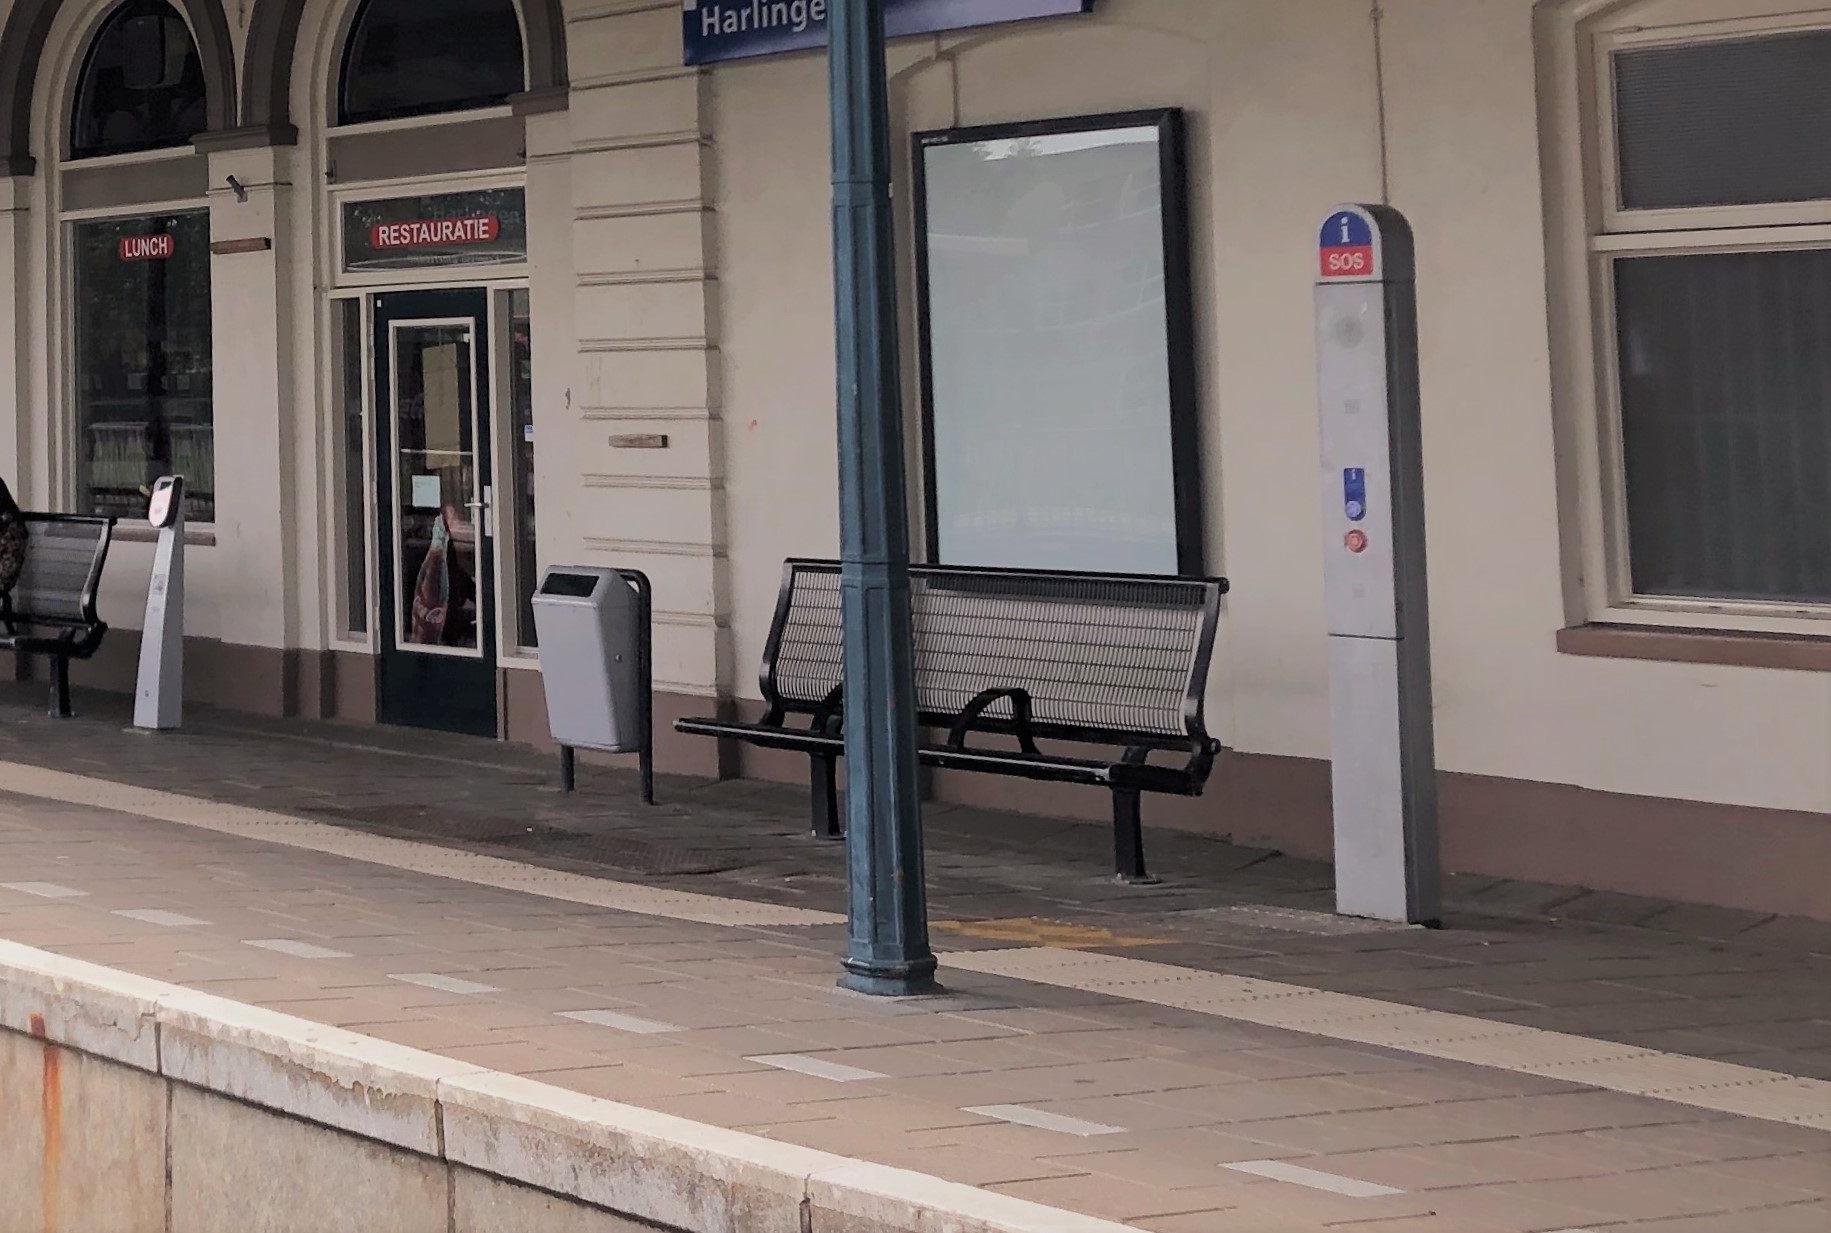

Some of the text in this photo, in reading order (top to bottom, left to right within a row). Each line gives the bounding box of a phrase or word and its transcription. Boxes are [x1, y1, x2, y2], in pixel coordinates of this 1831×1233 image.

[378, 218, 490, 246] RESTAURATIE
[124, 238, 168, 257] LUNCH
[1329, 252, 1364, 270] SOS
